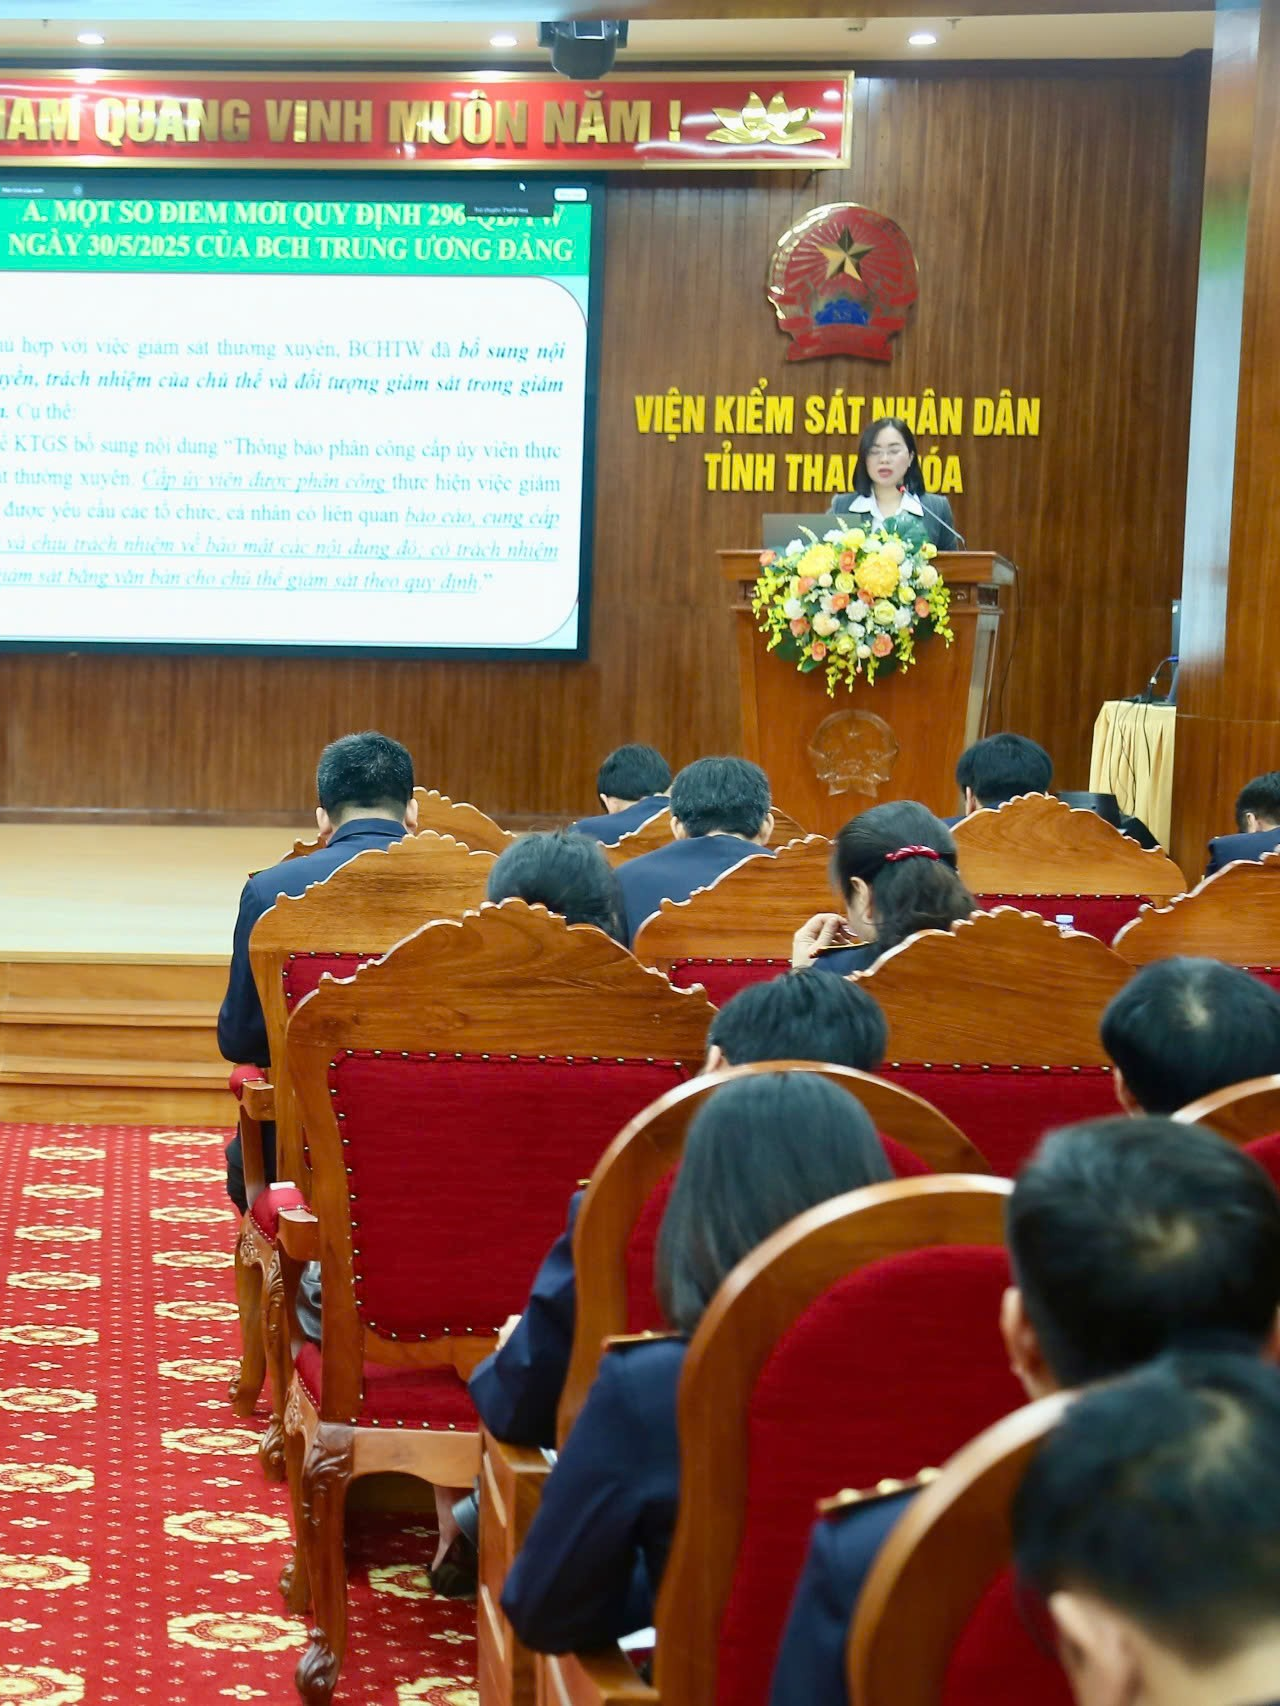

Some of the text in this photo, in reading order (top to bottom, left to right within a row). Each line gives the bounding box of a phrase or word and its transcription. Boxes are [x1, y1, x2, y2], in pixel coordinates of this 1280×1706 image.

[94, 97, 251, 147] QUANG
[265, 99, 373, 144] VINH
[388, 88, 528, 145] MUÔN
[543, 89, 652, 145] NĂM
[668, 99, 683, 143] !
[22, 200, 49, 222] A.
[293, 201, 352, 231] QUY
[355, 202, 423, 232] ĐỊNH
[8, 228, 574, 262] NGÀY 30/5/2025 CỦA BCH TRUNG ƯƠNG ĐẢNG
[348, 340, 422, 358] BCHTW
[634, 378, 1041, 442] VIỆN KIỂM SÁT NHÂN DÂN
[15, 436, 68, 452] KTGS
[704, 440, 964, 494] TỈNH THA ÓA
